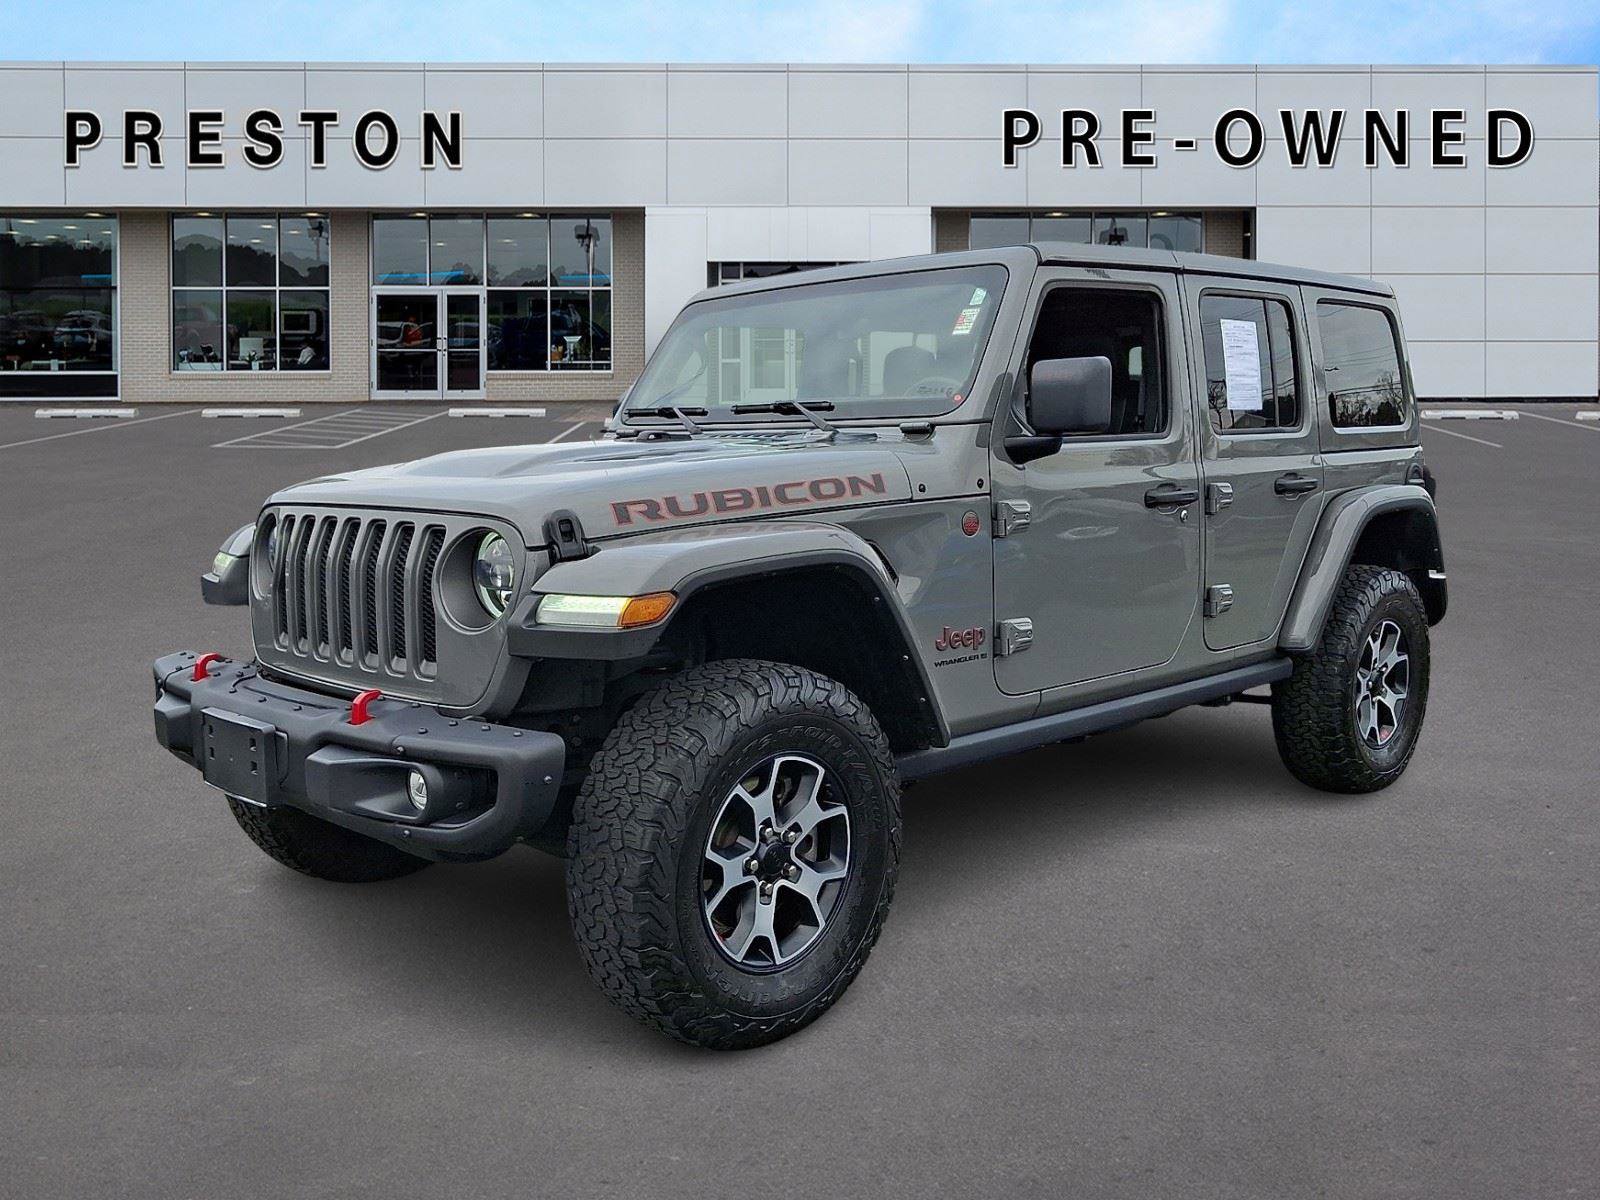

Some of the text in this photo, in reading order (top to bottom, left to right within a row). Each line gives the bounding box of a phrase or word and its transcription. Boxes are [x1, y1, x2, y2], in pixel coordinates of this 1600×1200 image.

[64, 108, 1535, 170] PRESTON PRE-OWNED
[610, 473, 887, 527] RUBICON
[935, 625, 986, 651] Jeep
[933, 654, 980, 668] WRANGLER
